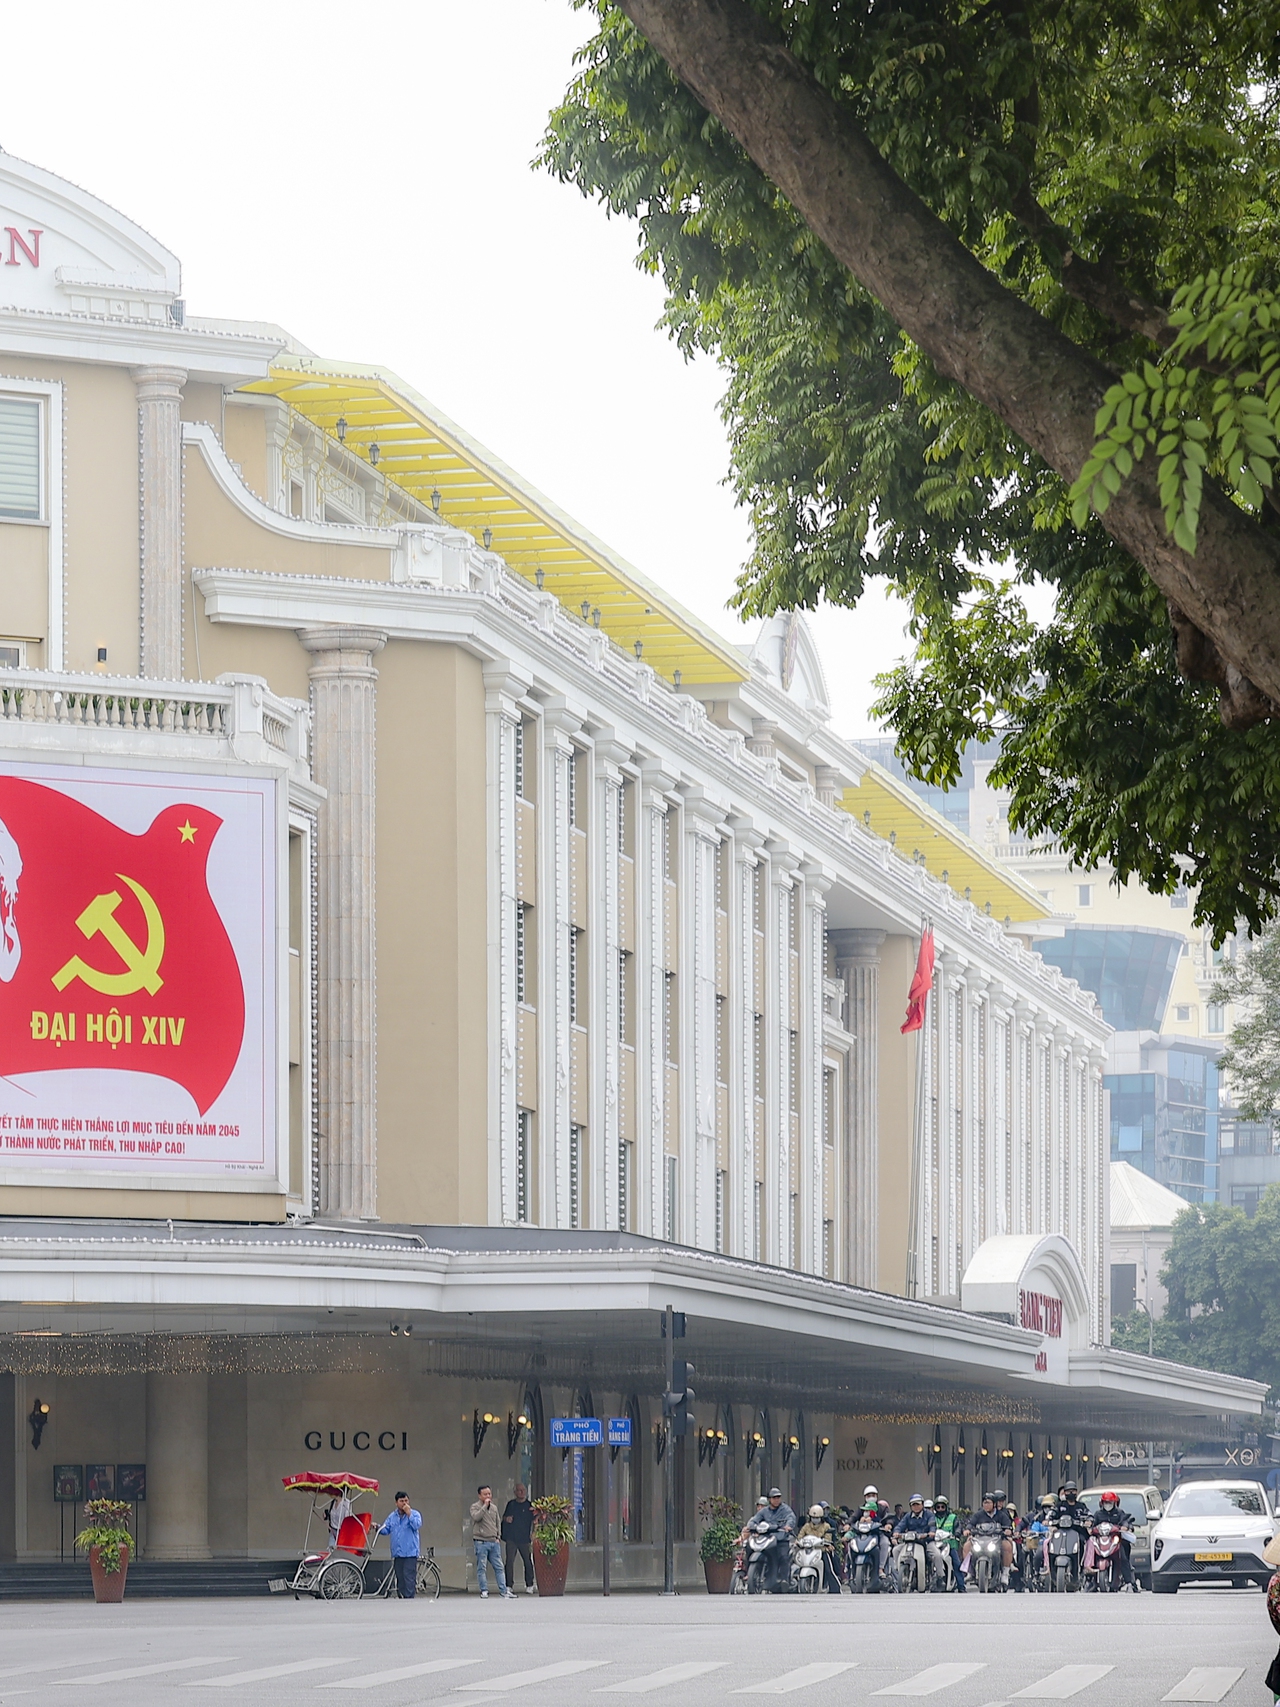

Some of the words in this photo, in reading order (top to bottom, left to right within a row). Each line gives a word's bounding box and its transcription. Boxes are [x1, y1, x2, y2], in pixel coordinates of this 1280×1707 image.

[30, 1011, 76, 1048] ĐẠI
[86, 1007, 132, 1050] HỘI
[141, 1016, 186, 1046] XIV
[15, 1115, 34, 1130] TÂM
[36, 1117, 59, 1133] THỰC
[61, 1117, 83, 1134] HIỆN
[85, 1116, 114, 1133] THẮNG
[117, 1119, 130, 1136] LỢI
[132, 1121, 153, 1136] MỤC
[155, 1120, 174, 1135] TIÊU
[176, 1119, 194, 1135] ĐẾN
[196, 1121, 216, 1137] NĂM
[218, 1124, 240, 1137] 2045
[5, 1134, 34, 1149] THÀNH
[37, 1134, 61, 1150] NƯỚC
[64, 1136, 86, 1151] PHÁT
[89, 1135, 116, 1153] TRIỂN,
[119, 1140, 135, 1152] THU
[138, 1139, 162, 1155] NHẬP
[165, 1142, 186, 1154] CAO!
[573, 1421, 590, 1429] PHỐ
[304, 1431, 407, 1451] GUCCI
[555, 1430, 581, 1443] TRÀNG
[582, 1428, 599, 1442] TIỀN
[836, 1458, 885, 1471] ROLEX
